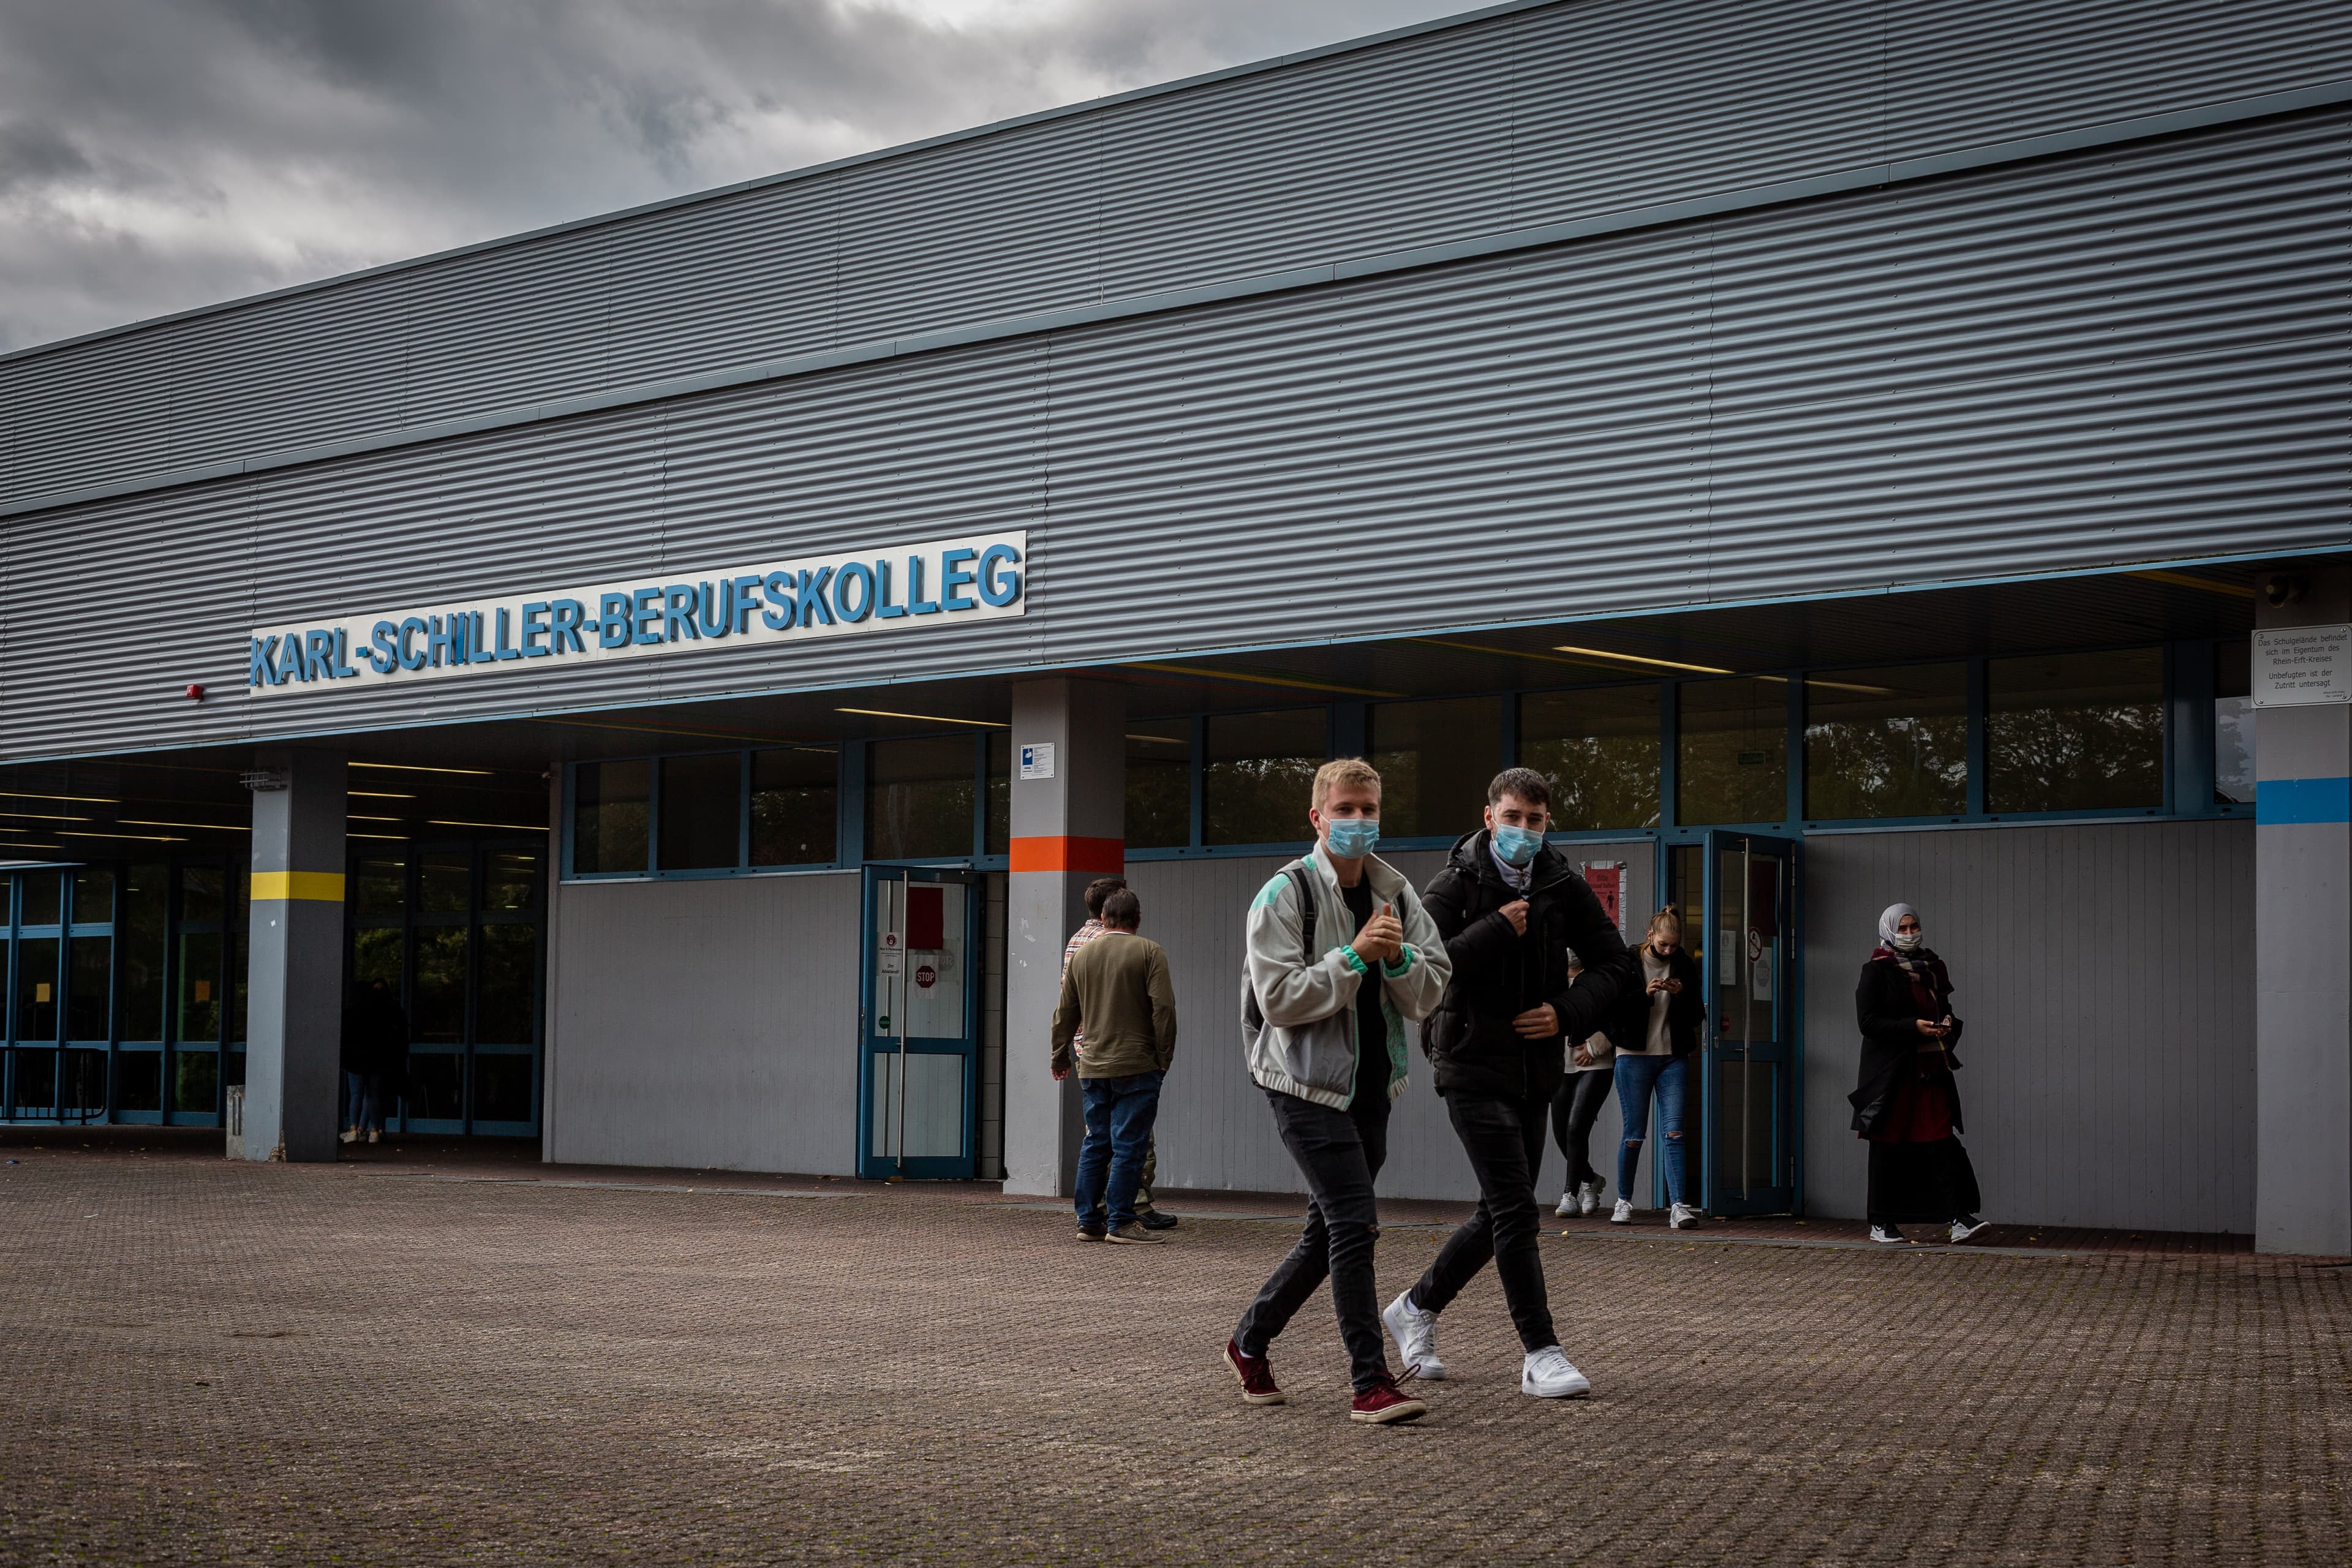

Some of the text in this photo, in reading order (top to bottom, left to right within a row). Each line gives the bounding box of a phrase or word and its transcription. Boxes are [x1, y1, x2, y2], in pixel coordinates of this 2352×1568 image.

[250, 544, 1017, 687] KARL-SCHILLER-BERUFSKOLLEG
[2274, 636, 2317, 646] Schulgelände
[2294, 646, 2324, 655] Eigentum
[2273, 655, 2332, 665] Rhein-Erft-Kreises
[2269, 671, 2306, 680] Unbefugten
[2299, 679, 2331, 688] untersagt
[917, 972, 935, 982] STOP
